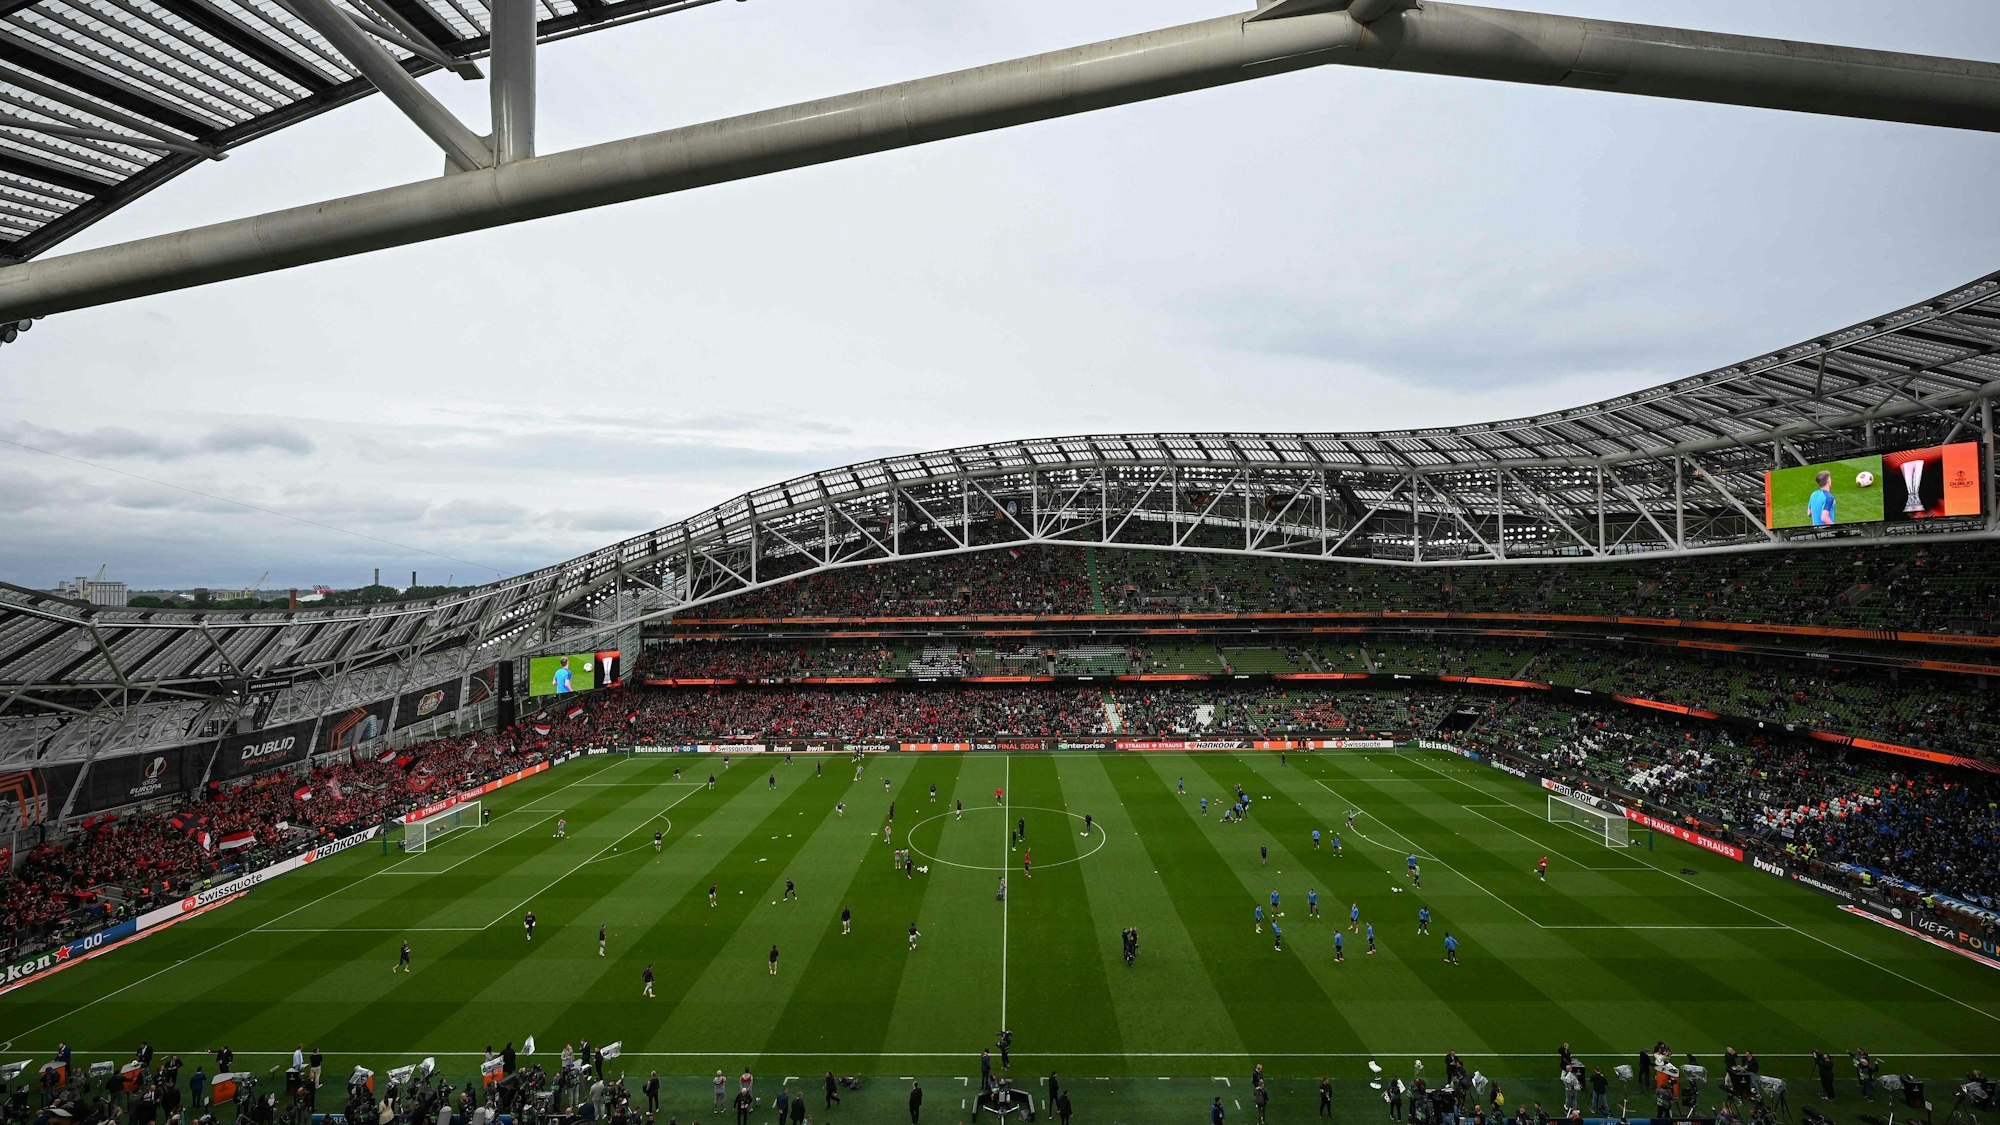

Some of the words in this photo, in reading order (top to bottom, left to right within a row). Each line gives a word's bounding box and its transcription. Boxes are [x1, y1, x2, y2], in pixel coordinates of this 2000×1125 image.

[241, 736, 295, 759] DUBLIN
[588, 747, 608, 755] bwin
[244, 756, 266, 766] FINAL
[267, 751, 288, 760] 2024
[1492, 761, 1526, 778] enterprise
[129, 783, 162, 795] EUROPA
[461, 788, 484, 801] STRAUSS
[421, 801, 447, 817] STRAUSS
[1643, 816, 1675, 835] STRAUSS
[1697, 837, 1735, 857] STRAUSS
[1753, 856, 1785, 877] bwin
[198, 873, 262, 905] Swissquote
[1918, 918, 1955, 939] UEFA
[84, 933, 103, 950] 0.0
